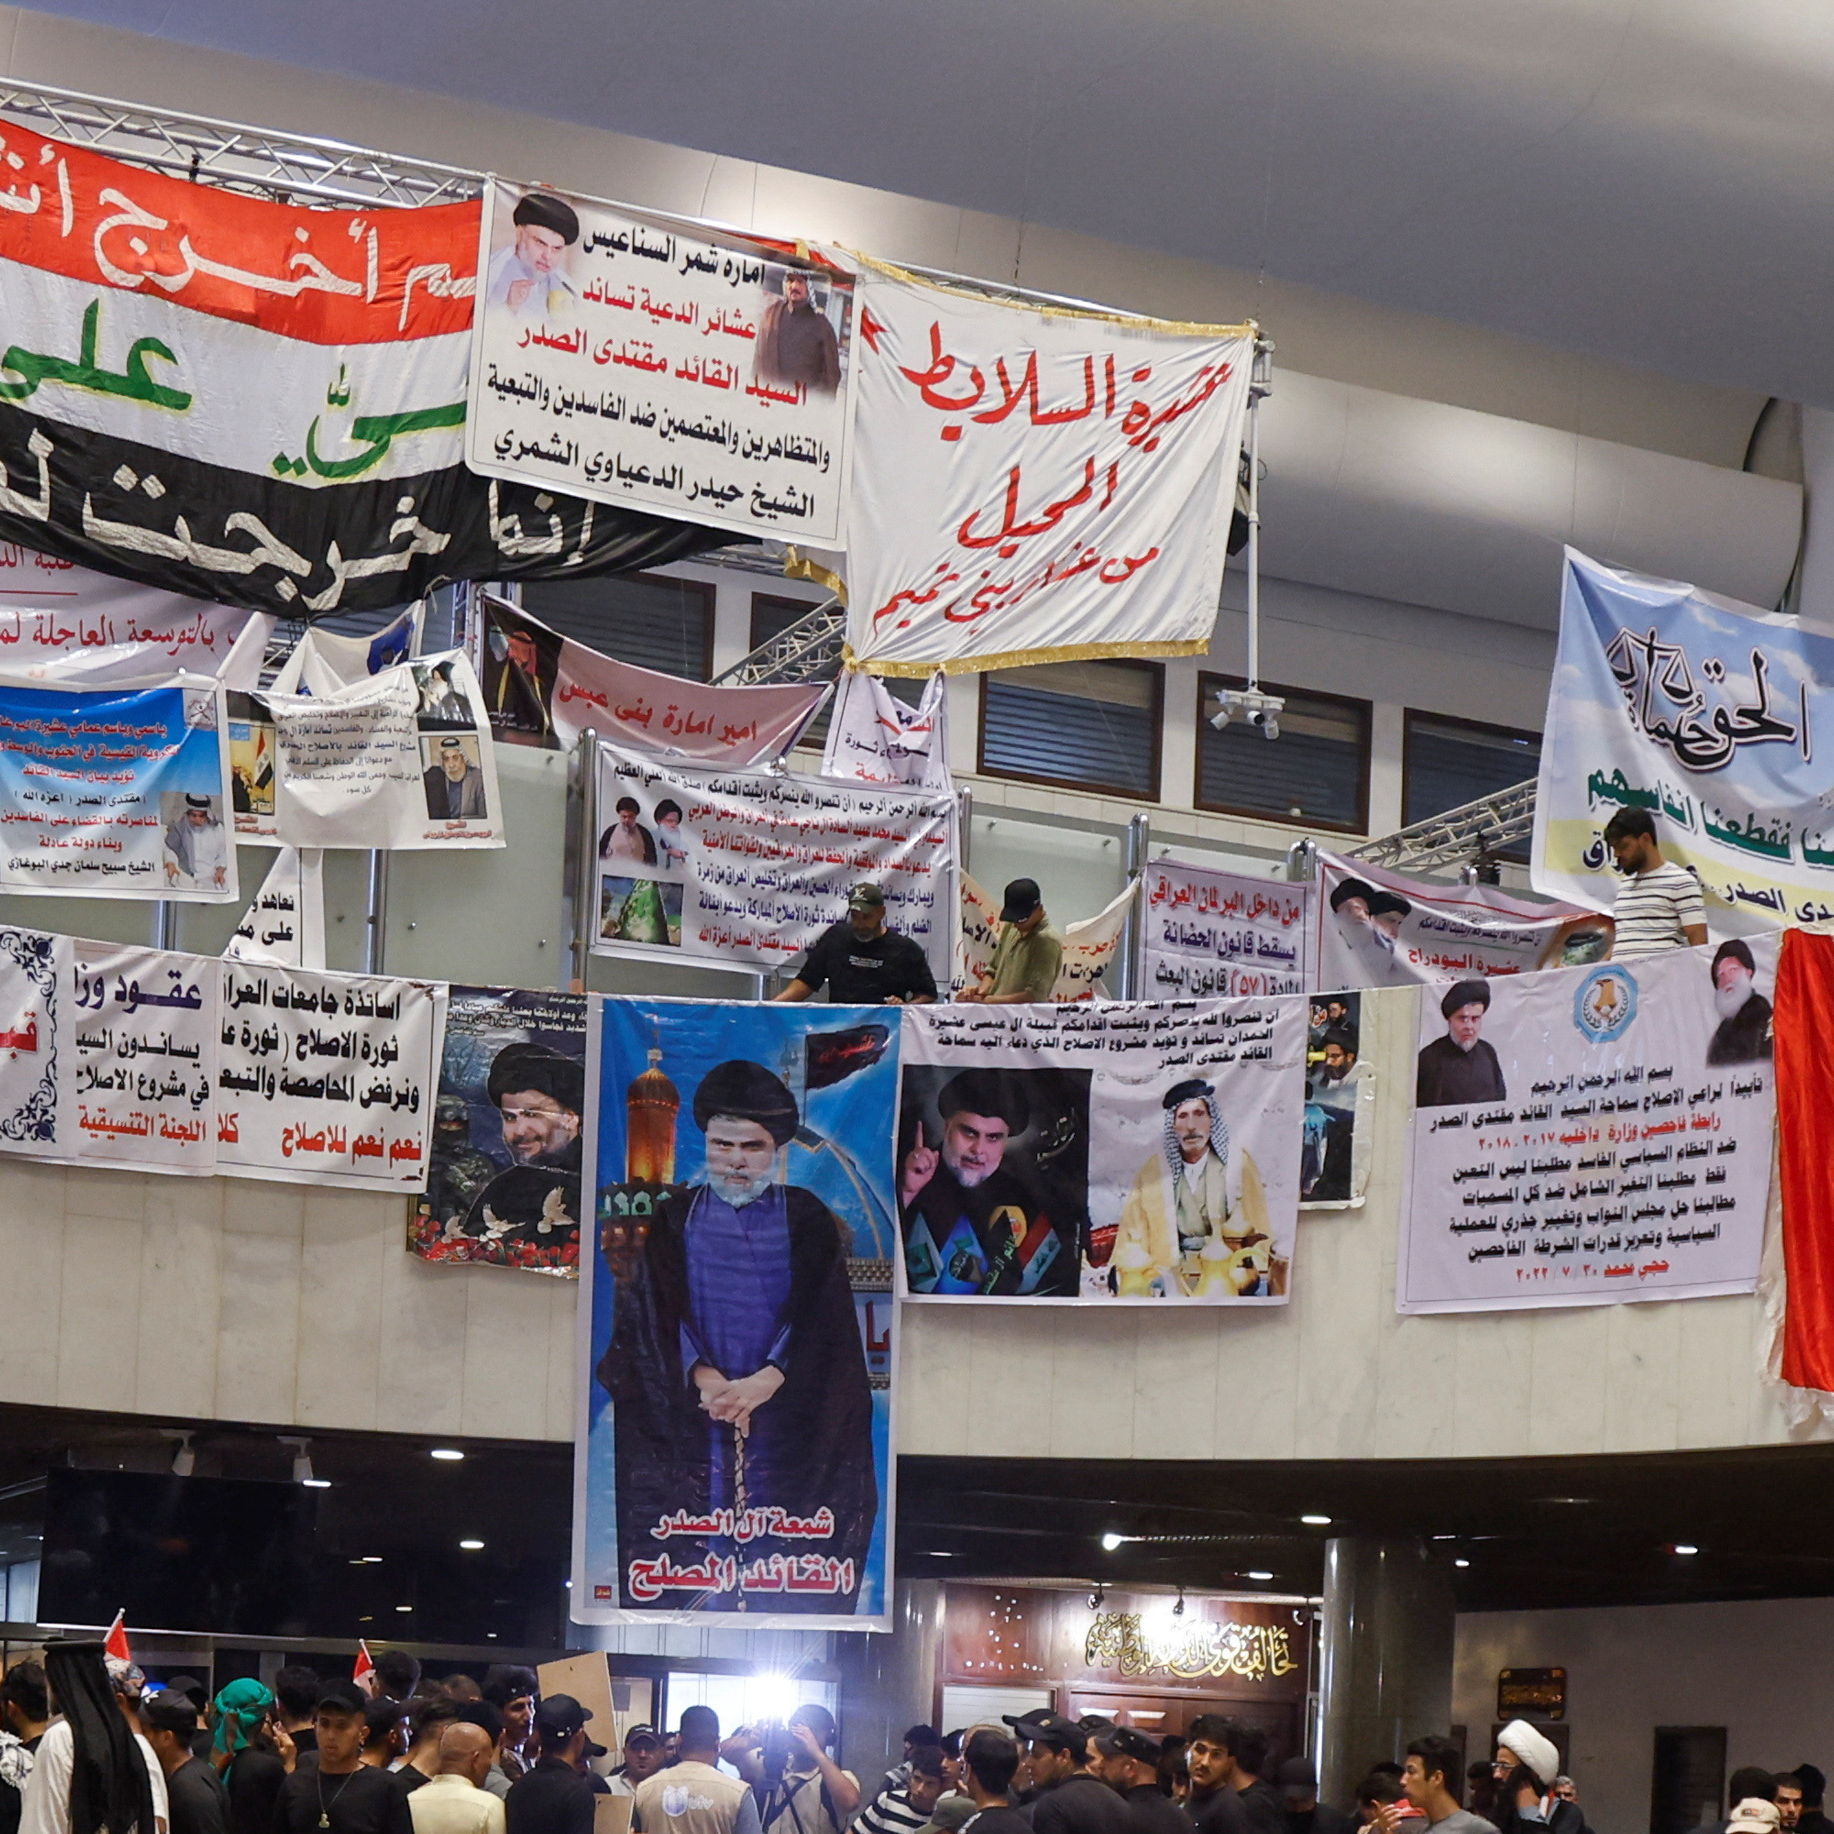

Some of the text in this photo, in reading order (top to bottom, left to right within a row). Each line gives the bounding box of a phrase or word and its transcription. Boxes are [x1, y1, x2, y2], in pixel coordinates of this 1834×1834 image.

[678, 245, 719, 275] شمر
[701, 307, 756, 339] عشائر
[517, 323, 807, 408] السيد القائد مقتدى الصدر
[553, 385, 626, 420] الفاسدين
[629, 401, 657, 429] ضد
[493, 428, 579, 468] الشمري
[687, 471, 745, 504] حيدر
[749, 480, 815, 520] الشيخ
[261, 921, 293, 944] على
[272, 982, 339, 1020] جامعات
[296, 1028, 398, 1067] ثورة الاصلاح
[137, 1070, 209, 1111] في مشروع
[1561, 1098, 1596, 1118] السيد
[159, 1112, 207, 1147] اللجنة
[1430, 1110, 1467, 1131] الصدر
[1472, 1109, 1514, 1129] مقتدى
[352, 1126, 384, 1166] نعم
[389, 1130, 422, 1169] نعم
[651, 1512, 733, 1539] الصدر
[629, 1556, 854, 1600] القائد المصلح
